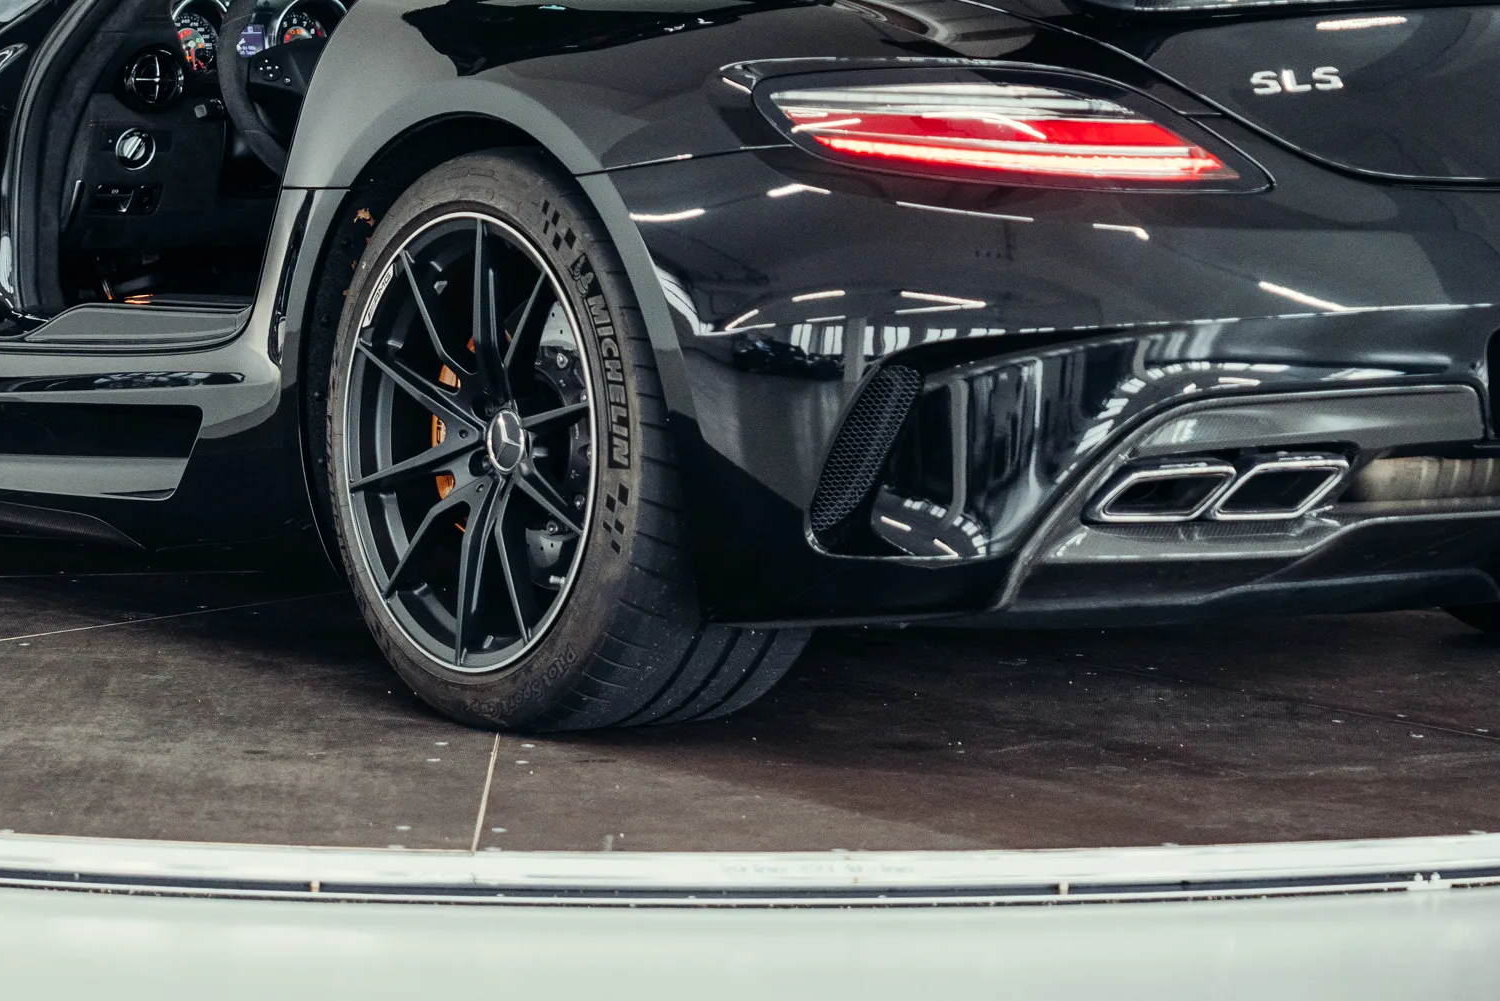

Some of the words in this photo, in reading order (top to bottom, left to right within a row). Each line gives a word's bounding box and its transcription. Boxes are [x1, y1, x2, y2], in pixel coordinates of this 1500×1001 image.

[1250, 66, 1344, 95] SLS
[586, 294, 630, 468] MICHELIN
[542, 641, 578, 686] Pilot
[469, 698, 500, 718] Cup
[501, 678, 543, 715] Sport
